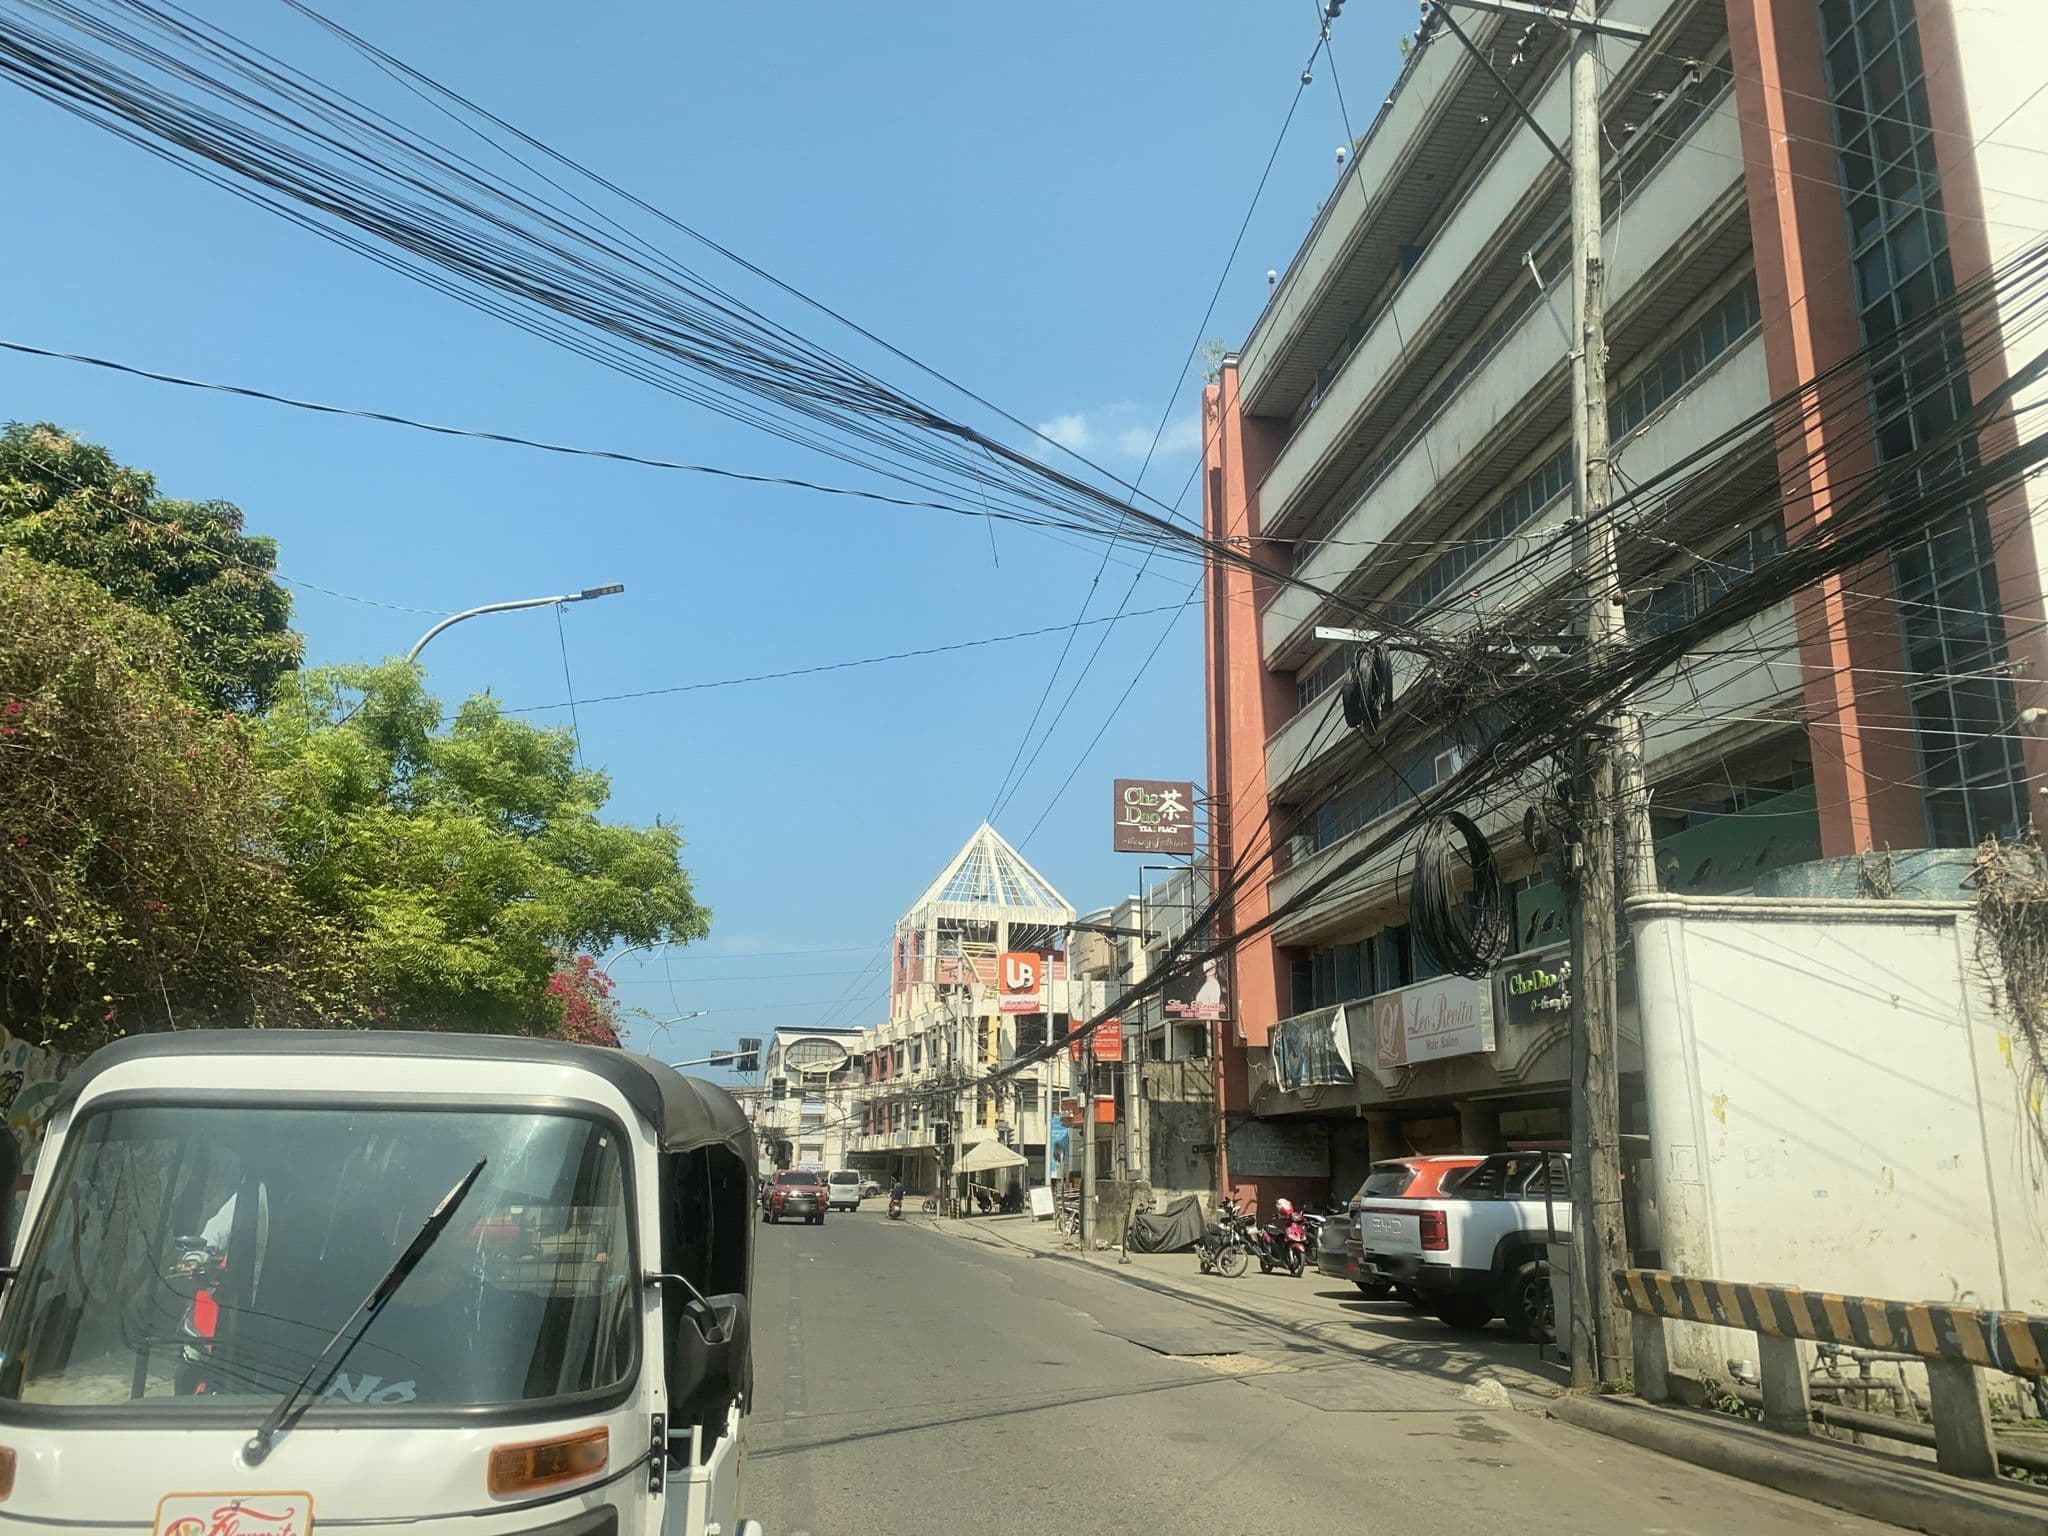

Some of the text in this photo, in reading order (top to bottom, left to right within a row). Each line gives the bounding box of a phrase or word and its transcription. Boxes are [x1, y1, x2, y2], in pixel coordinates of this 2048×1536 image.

[1124, 787, 1159, 806] Cha
[1157, 789, 1190, 821] 茶
[1124, 805, 1161, 824] Dao
[1425, 1035, 1459, 1051] Hair Salon
